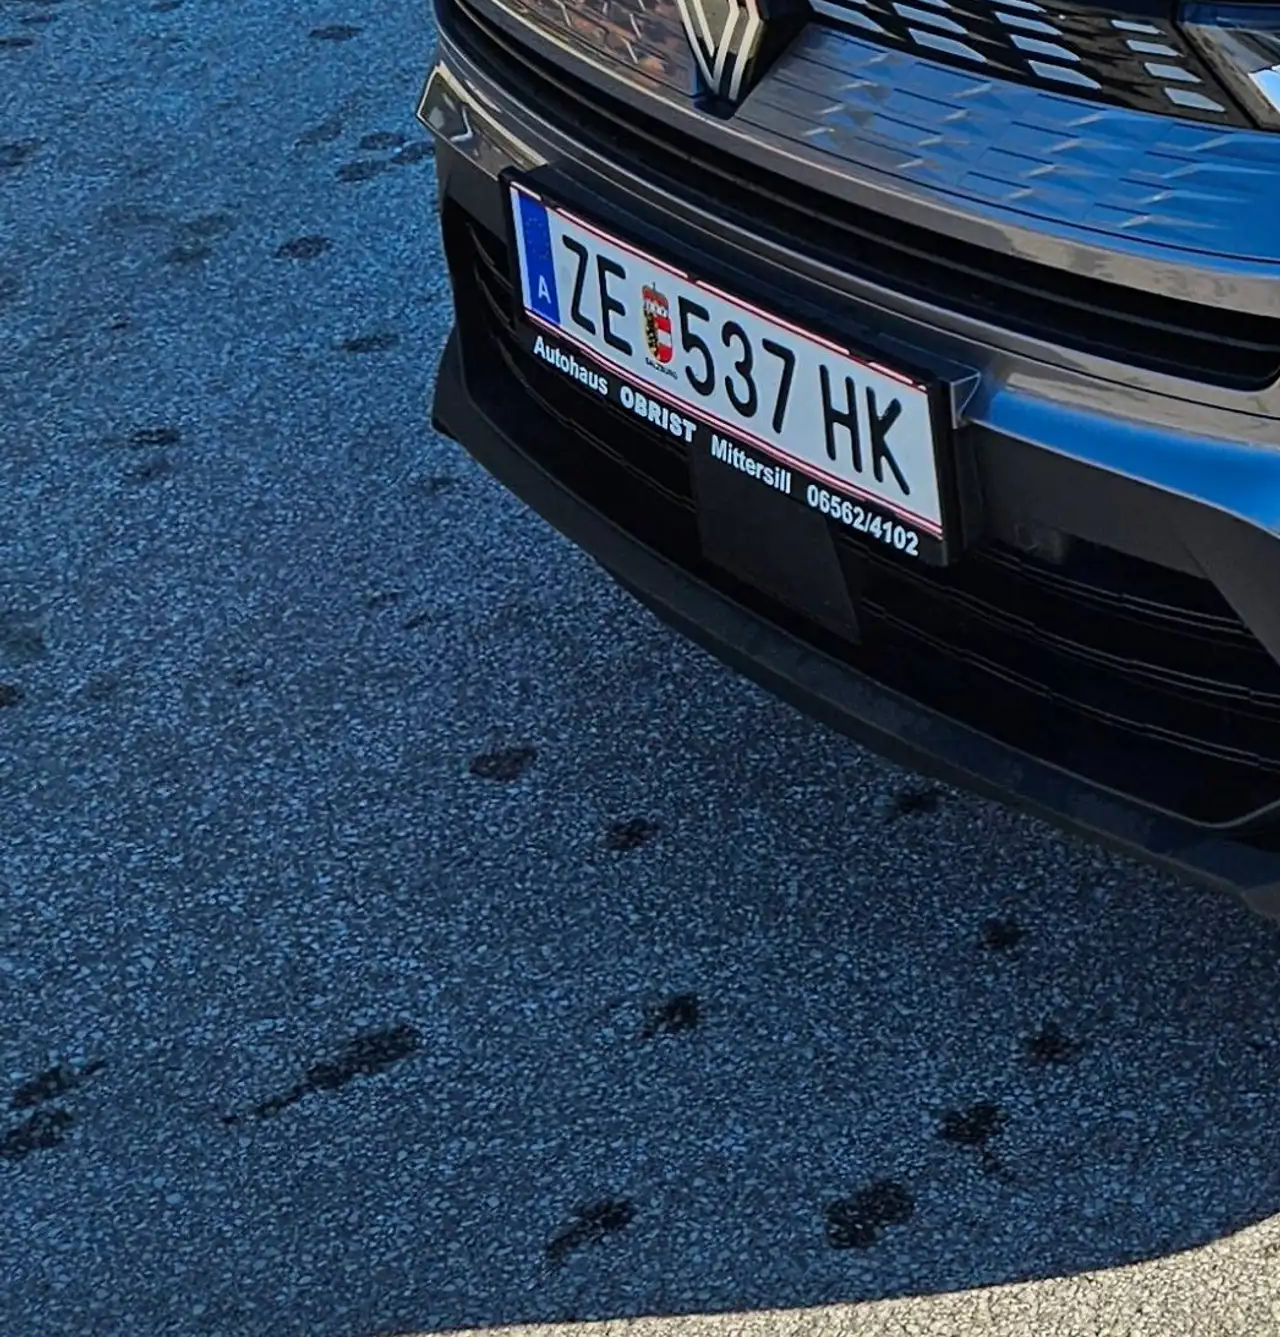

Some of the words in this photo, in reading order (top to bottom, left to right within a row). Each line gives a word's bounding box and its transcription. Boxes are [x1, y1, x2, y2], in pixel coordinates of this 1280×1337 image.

[537, 275, 552, 305] A
[561, 234, 633, 357] ZE
[677, 295, 796, 435] 537
[818, 364, 911, 496] HK
[533, 335, 609, 396] Autohaus
[619, 385, 697, 443] OBRIST
[711, 433, 792, 495] Mittersill
[805, 483, 920, 557] 06562/4102
